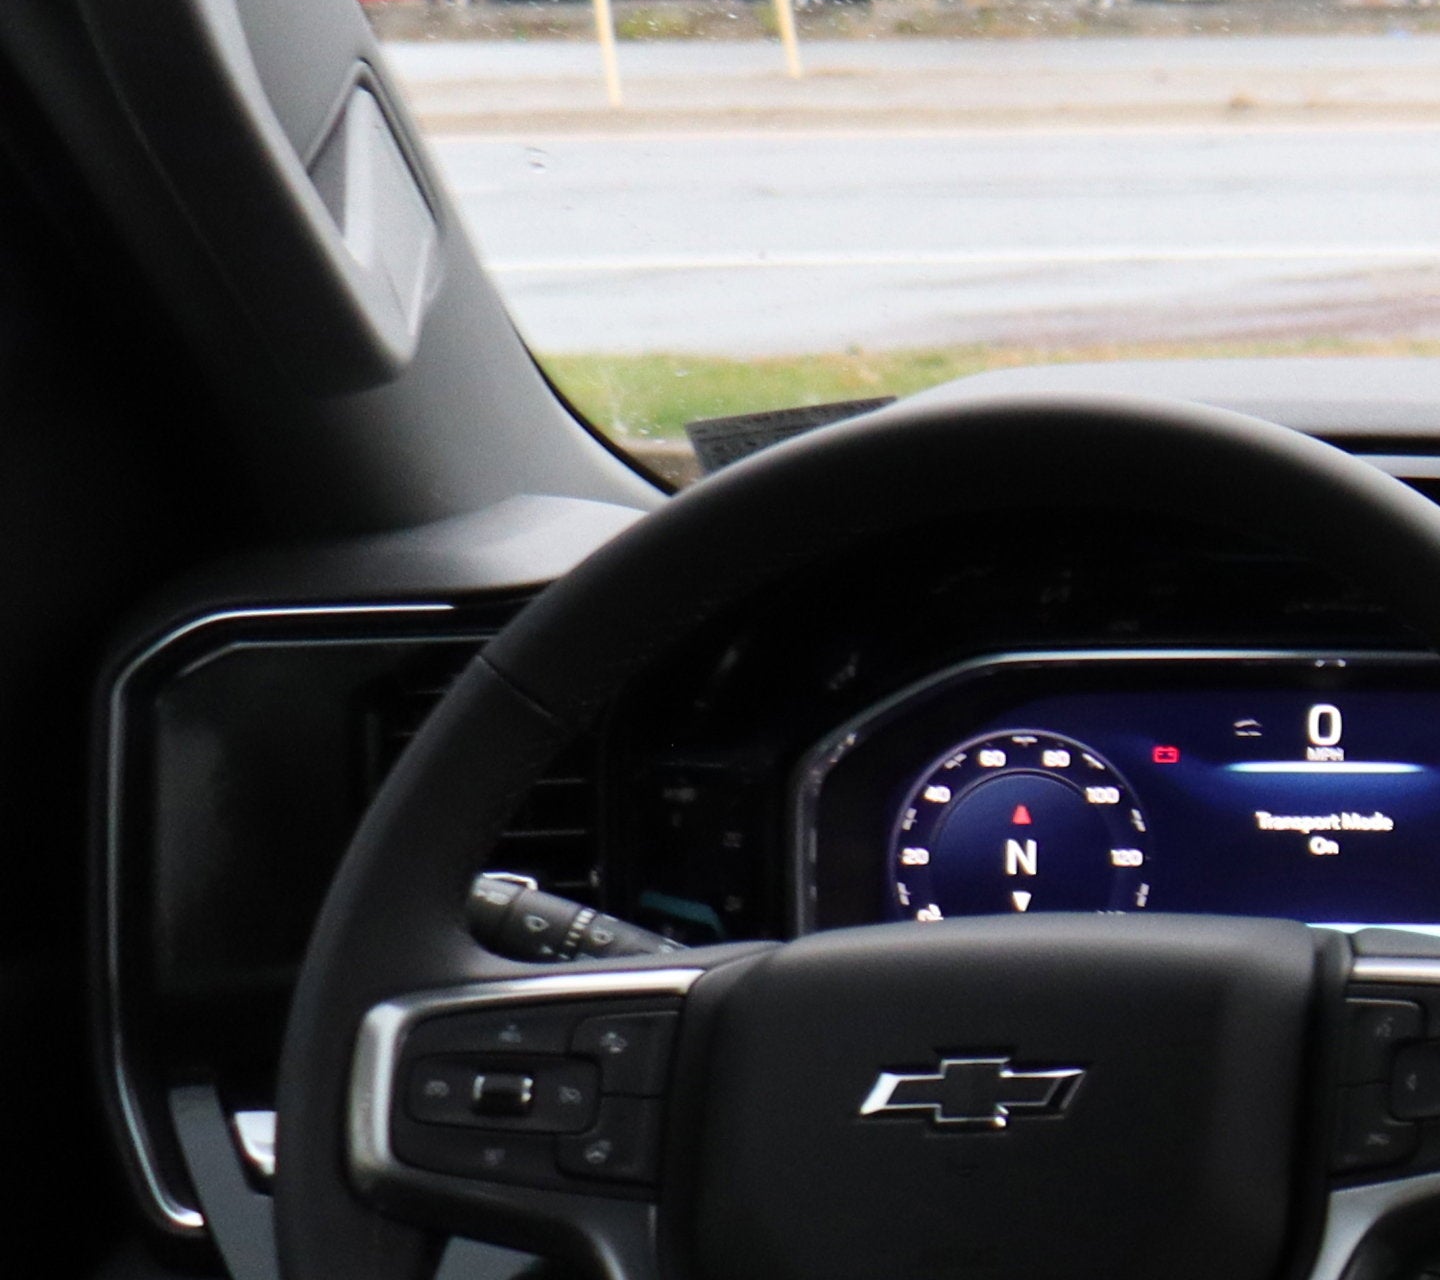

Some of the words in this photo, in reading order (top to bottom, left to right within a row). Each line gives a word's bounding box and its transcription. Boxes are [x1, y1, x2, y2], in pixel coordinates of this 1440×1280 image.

[1306, 703, 1343, 747] 0
[1254, 810, 1339, 833] Transport
[1341, 811, 1395, 833] Mode
[1004, 838, 1038, 876] N
[1308, 837, 1340, 856] On
